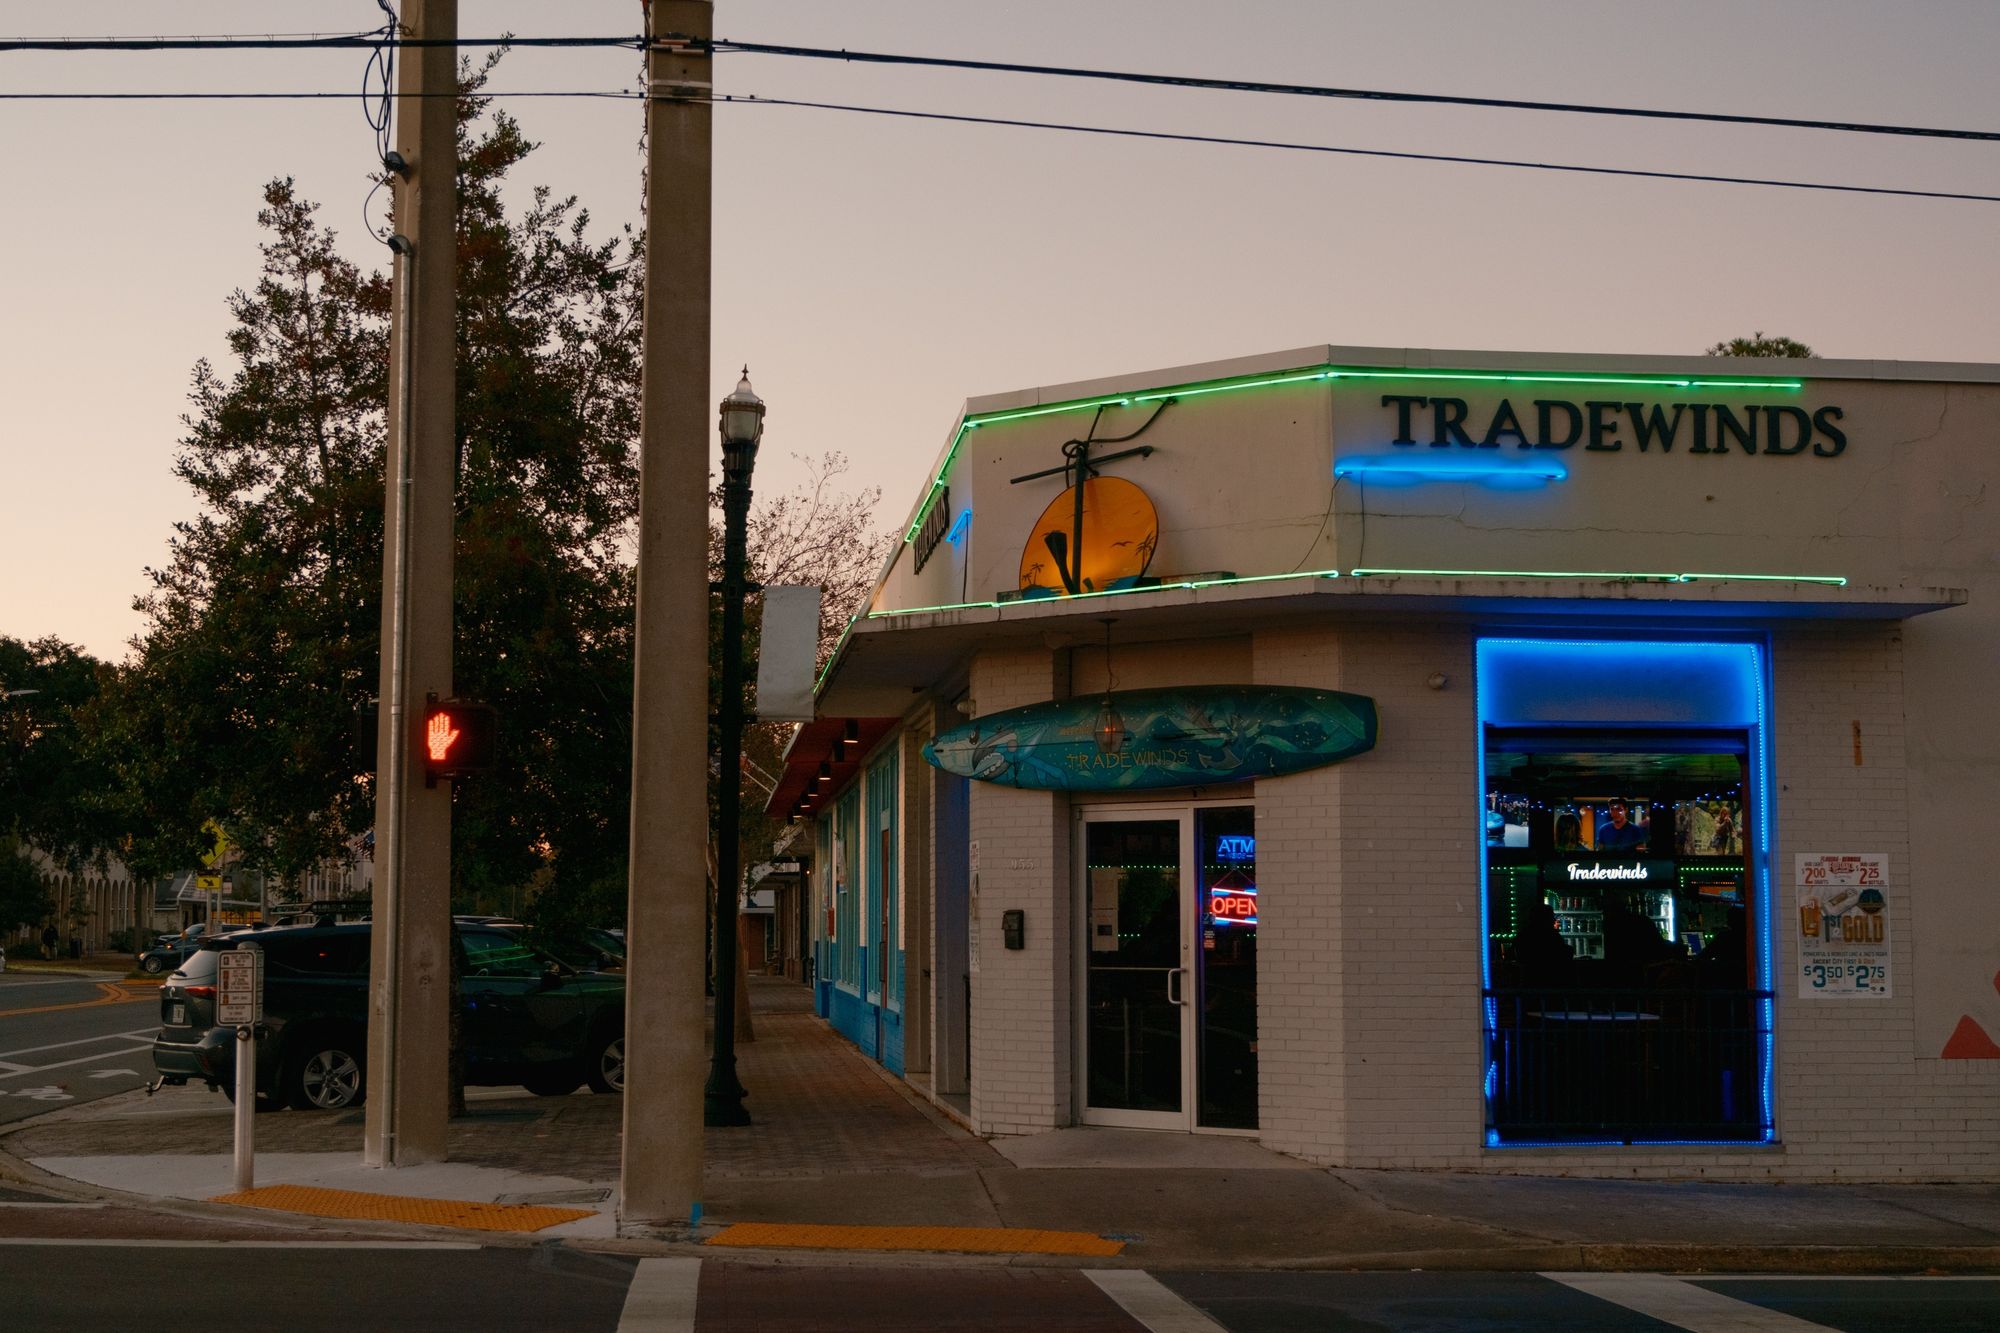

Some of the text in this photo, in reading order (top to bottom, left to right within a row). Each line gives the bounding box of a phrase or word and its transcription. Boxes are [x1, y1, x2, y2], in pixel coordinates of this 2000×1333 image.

[1381, 395, 1847, 458] TRADEWINDS
[1218, 839, 1255, 853] ATM
[1567, 862, 1648, 880] Tradewinds
[1211, 897, 1257, 915] OPEN
[1843, 915, 1883, 943] GOLD
